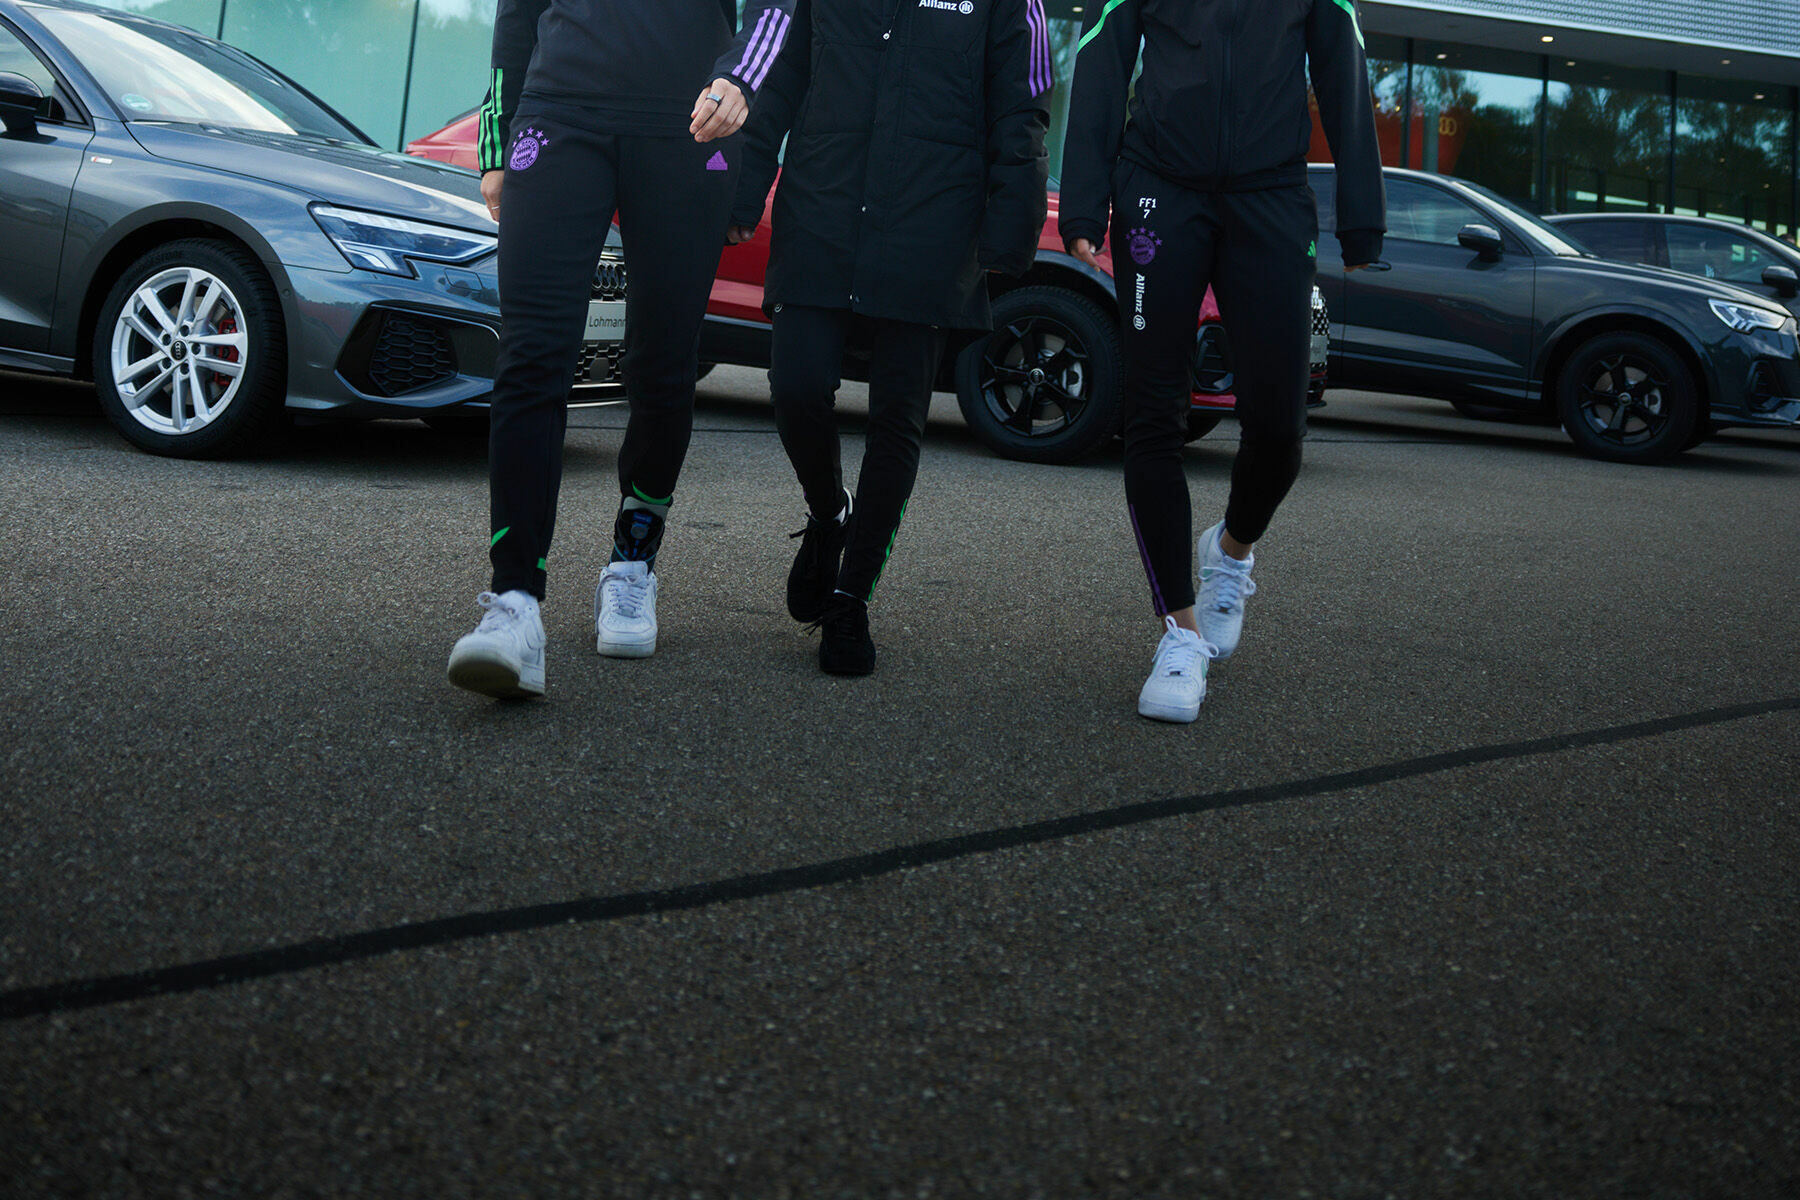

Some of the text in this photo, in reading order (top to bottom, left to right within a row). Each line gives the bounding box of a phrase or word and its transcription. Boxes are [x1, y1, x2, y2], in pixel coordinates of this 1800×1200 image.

[1139, 197, 1156, 208] FF1
[1143, 209, 1150, 219] 7
[1135, 273, 1145, 313] Allianz
